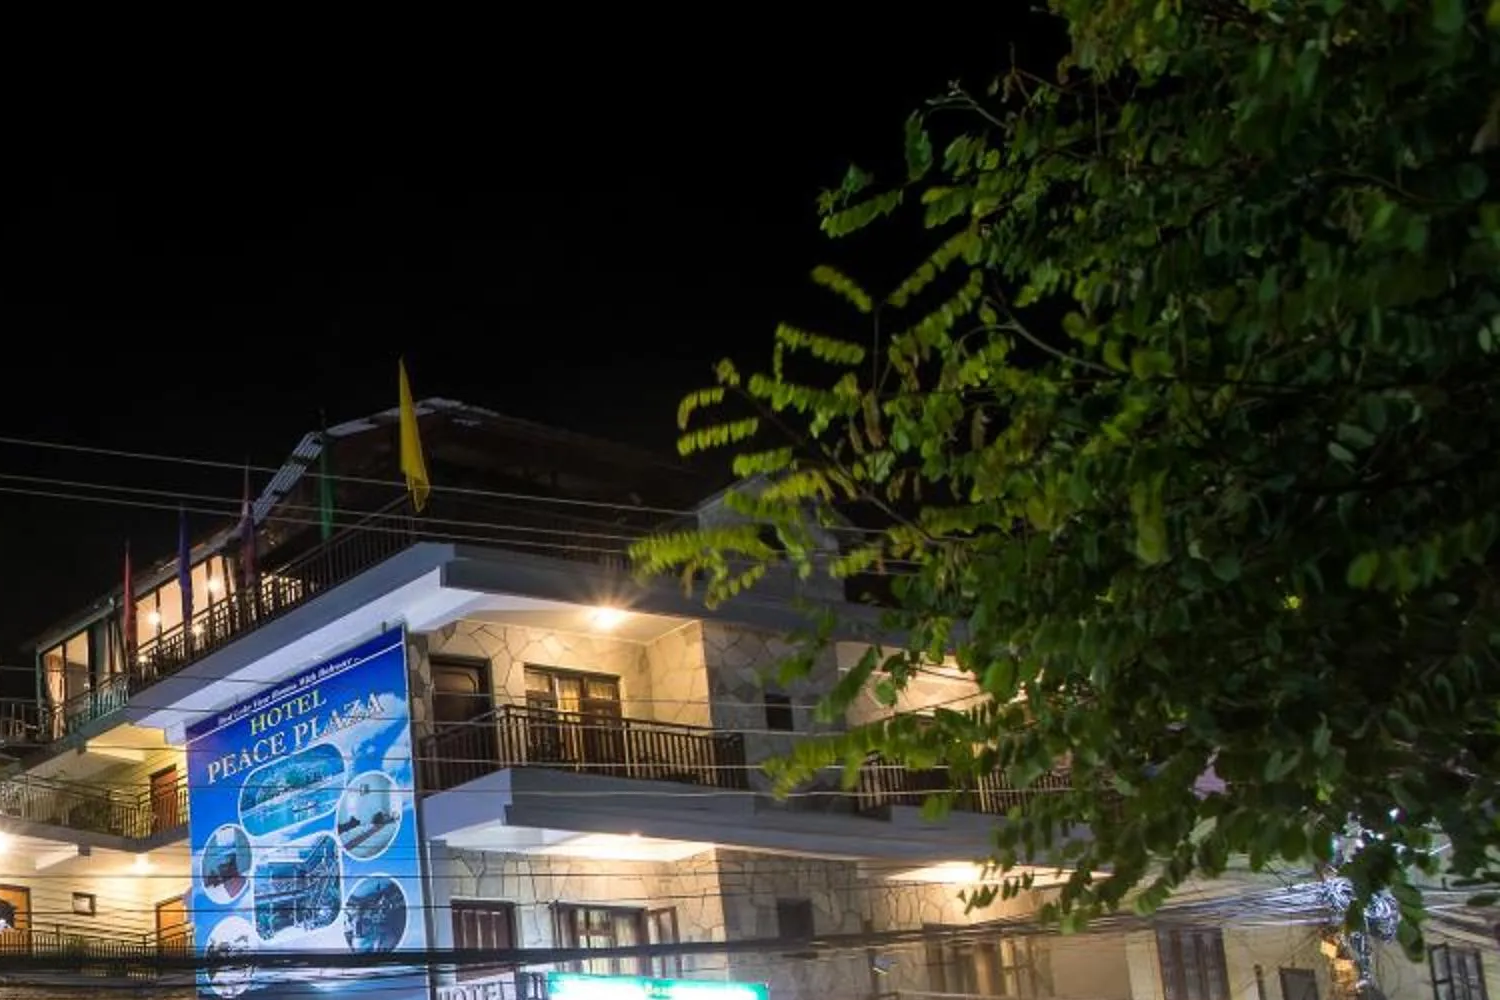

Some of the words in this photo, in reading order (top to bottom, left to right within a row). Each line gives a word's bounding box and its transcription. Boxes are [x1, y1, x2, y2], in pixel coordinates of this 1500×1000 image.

[207, 731, 287, 784] PEACE
[293, 692, 385, 748] PLAZA
[251, 689, 327, 736] HOTEL
